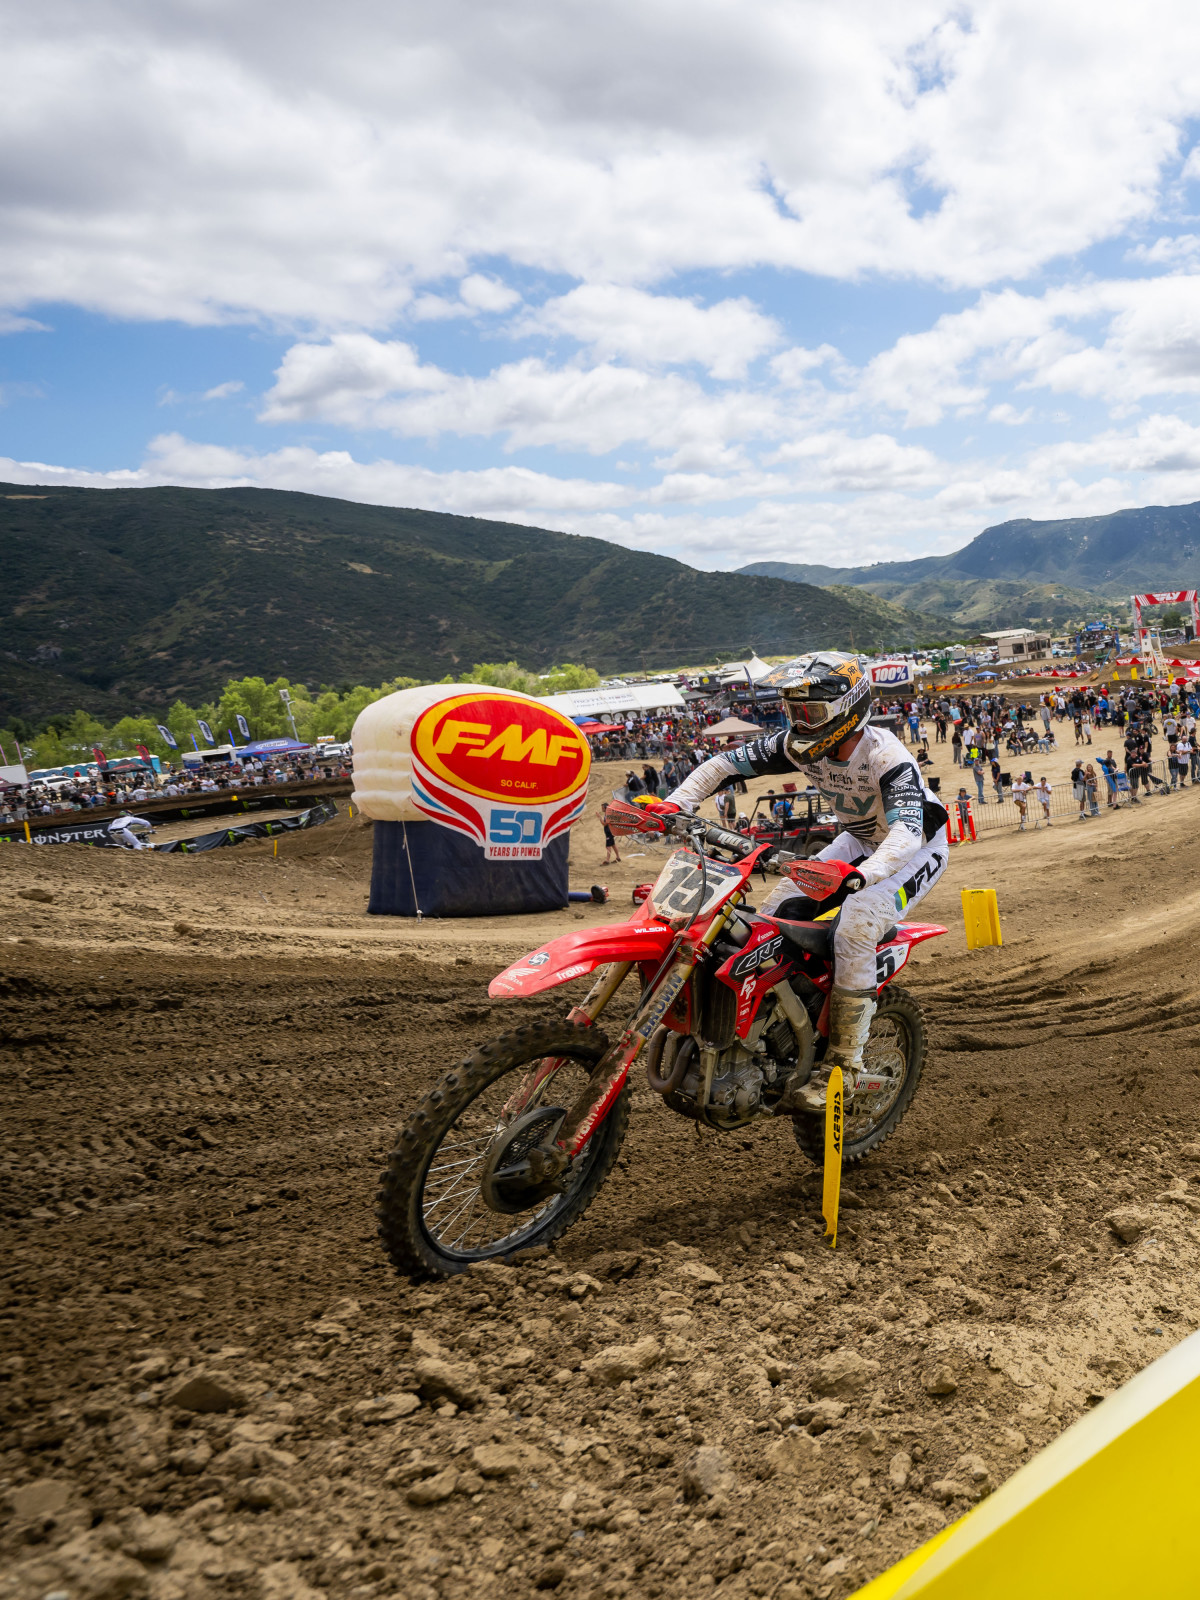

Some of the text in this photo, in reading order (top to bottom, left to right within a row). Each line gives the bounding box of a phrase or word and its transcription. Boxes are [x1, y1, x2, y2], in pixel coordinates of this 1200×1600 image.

[1152, 591, 1181, 602] FLY
[875, 666, 907, 682] 100%
[434, 718, 581, 767] FMF
[808, 713, 860, 758] ROCKSTAR
[500, 779, 513, 787] SO
[819, 786, 876, 816] FLY
[489, 809, 543, 844] 50
[489, 846, 541, 857] YEARS OF POWER
[652, 865, 726, 914] 15
[634, 926, 667, 934] WILSON
[735, 935, 784, 976] CRF
[556, 965, 585, 981] froth
[638, 972, 684, 1038] BROWN
[833, 1091, 841, 1154] ACERBIS
